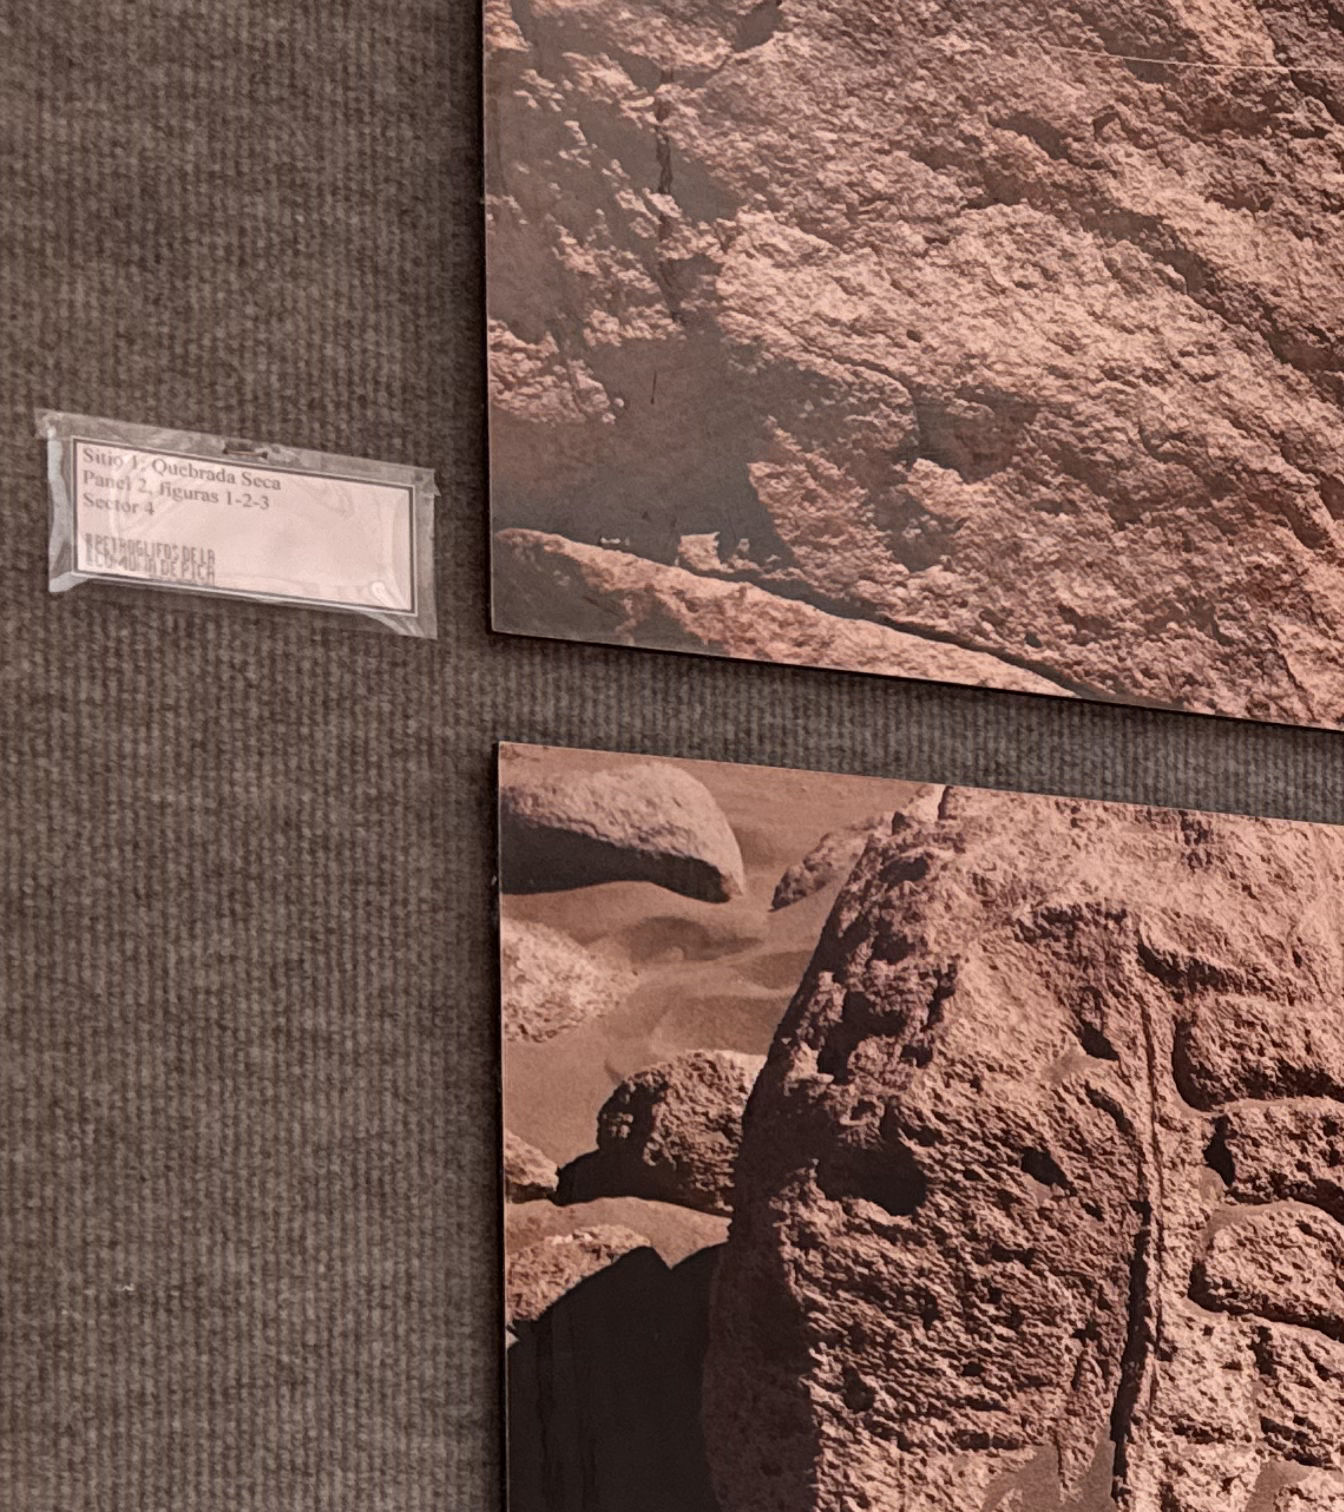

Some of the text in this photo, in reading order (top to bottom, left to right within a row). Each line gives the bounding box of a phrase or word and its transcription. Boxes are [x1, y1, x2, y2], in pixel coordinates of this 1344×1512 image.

[82, 448, 124, 470] Sitio
[151, 459, 236, 486] Quebrada
[241, 472, 282, 491] Seca
[82, 493, 155, 517] Sector 4
[83, 471, 131, 492] Panel
[158, 481, 219, 506] figuras
[226, 491, 270, 510] 1-2-3
